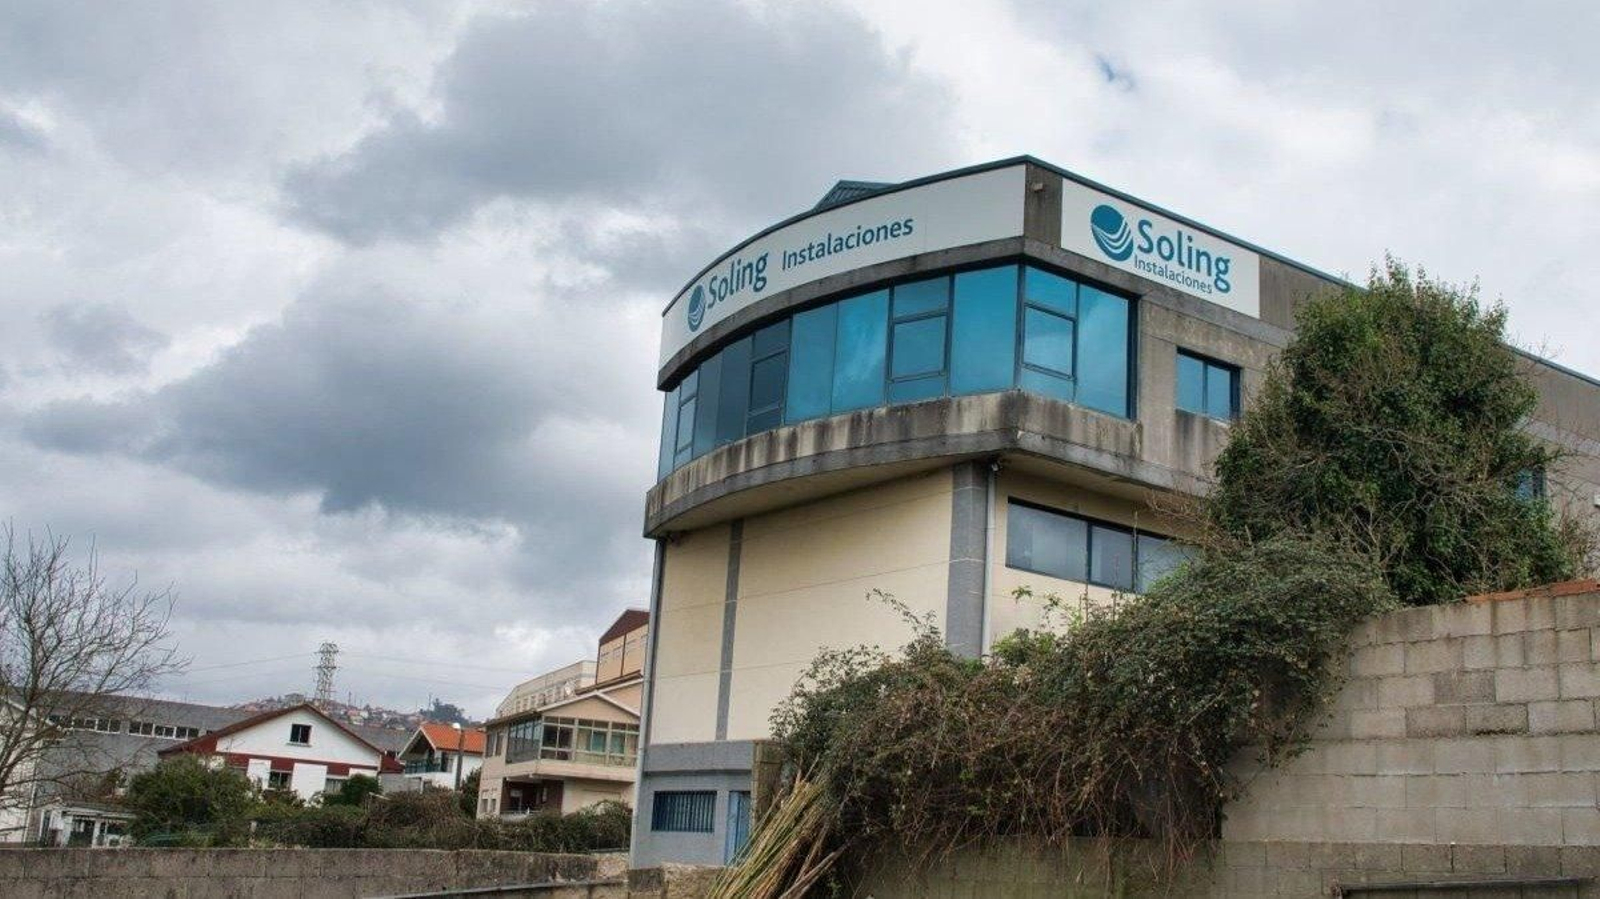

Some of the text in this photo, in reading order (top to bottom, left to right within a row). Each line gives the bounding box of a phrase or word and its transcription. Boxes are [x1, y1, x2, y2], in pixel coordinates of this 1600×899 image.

[707, 218, 914, 309] Soling Instalaciones
[1134, 254, 1213, 295] Instalaciones
[1136, 219, 1231, 294] Soling
